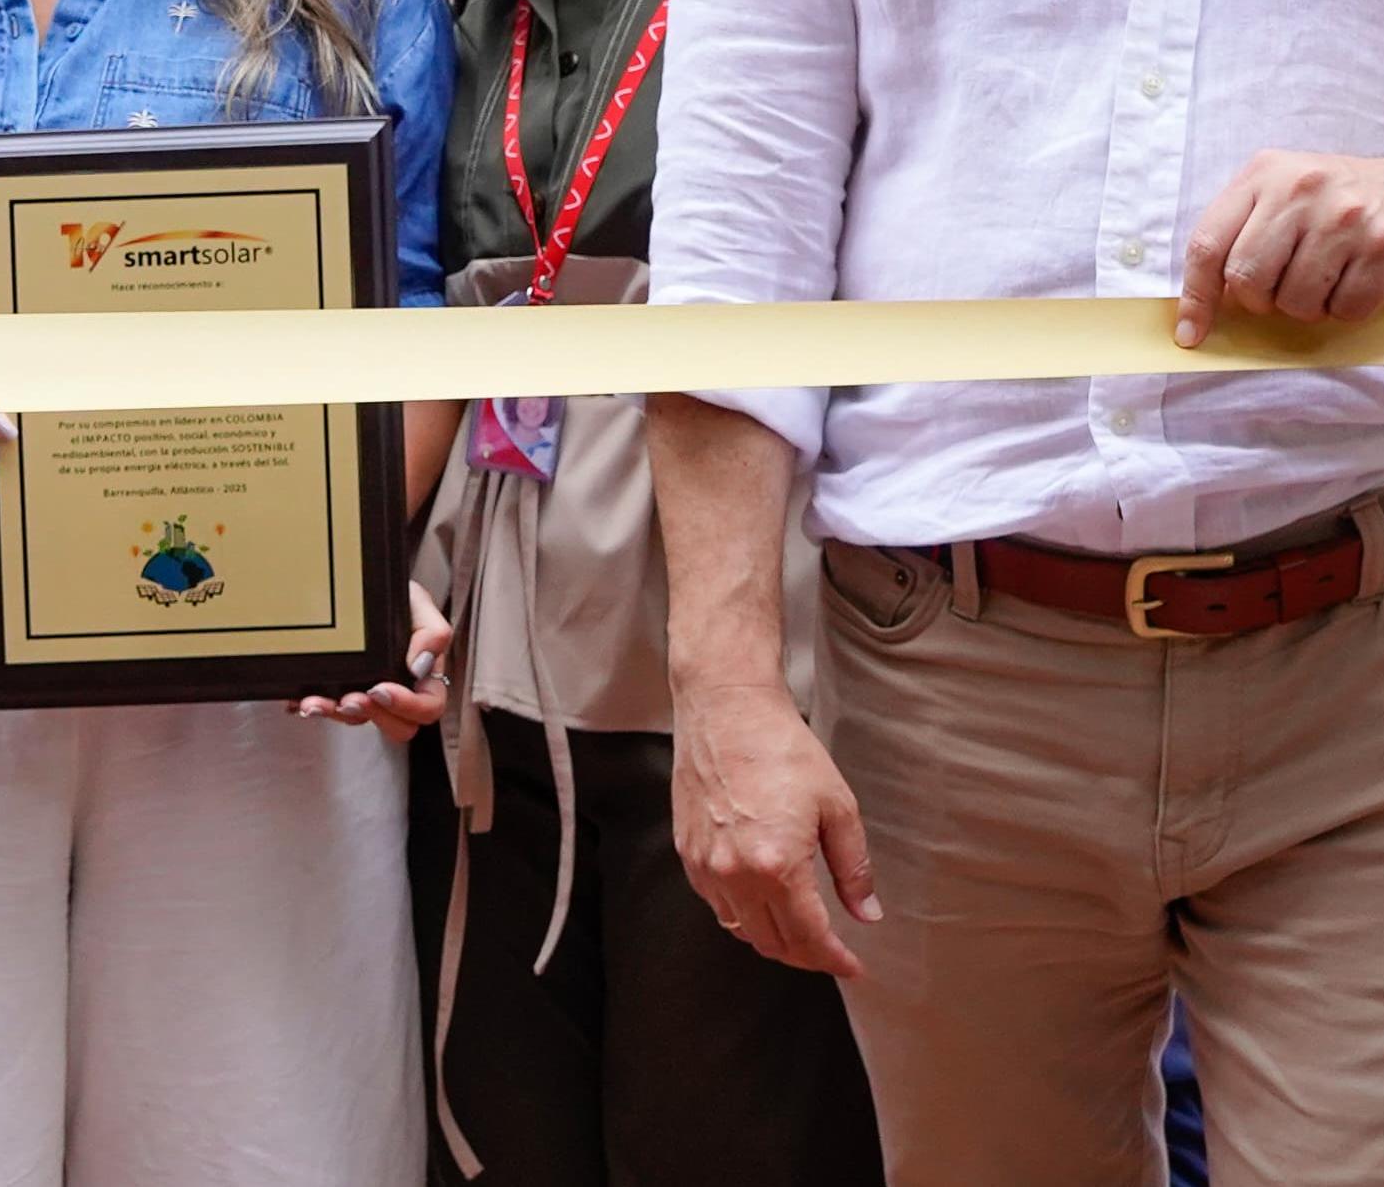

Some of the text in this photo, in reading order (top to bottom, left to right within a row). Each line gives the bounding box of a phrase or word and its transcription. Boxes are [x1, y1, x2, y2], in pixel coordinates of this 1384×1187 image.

[111, 281, 134, 291] Hace
[138, 279, 213, 290] reconocimiento
[58, 421, 75, 430] Por
[93, 420, 157, 431] compromiso
[175, 416, 207, 426] liderar
[225, 413, 284, 424] COLOMBIA
[71, 434, 80, 445] el
[82, 433, 132, 444] IMPACTO
[212, 429, 269, 439] económico
[140, 449, 158, 457] con
[161, 447, 169, 456] la
[172, 445, 229, 457] producción
[231, 442, 295, 453] SOSTENIBLE
[58, 465, 71, 474] de
[74, 466, 86, 474] su
[89, 464, 121, 475] propia
[220, 460, 251, 469] través
[254, 457, 270, 467] del
[170, 485, 215, 495] Atlántico
[223, 483, 247, 494] 2025
